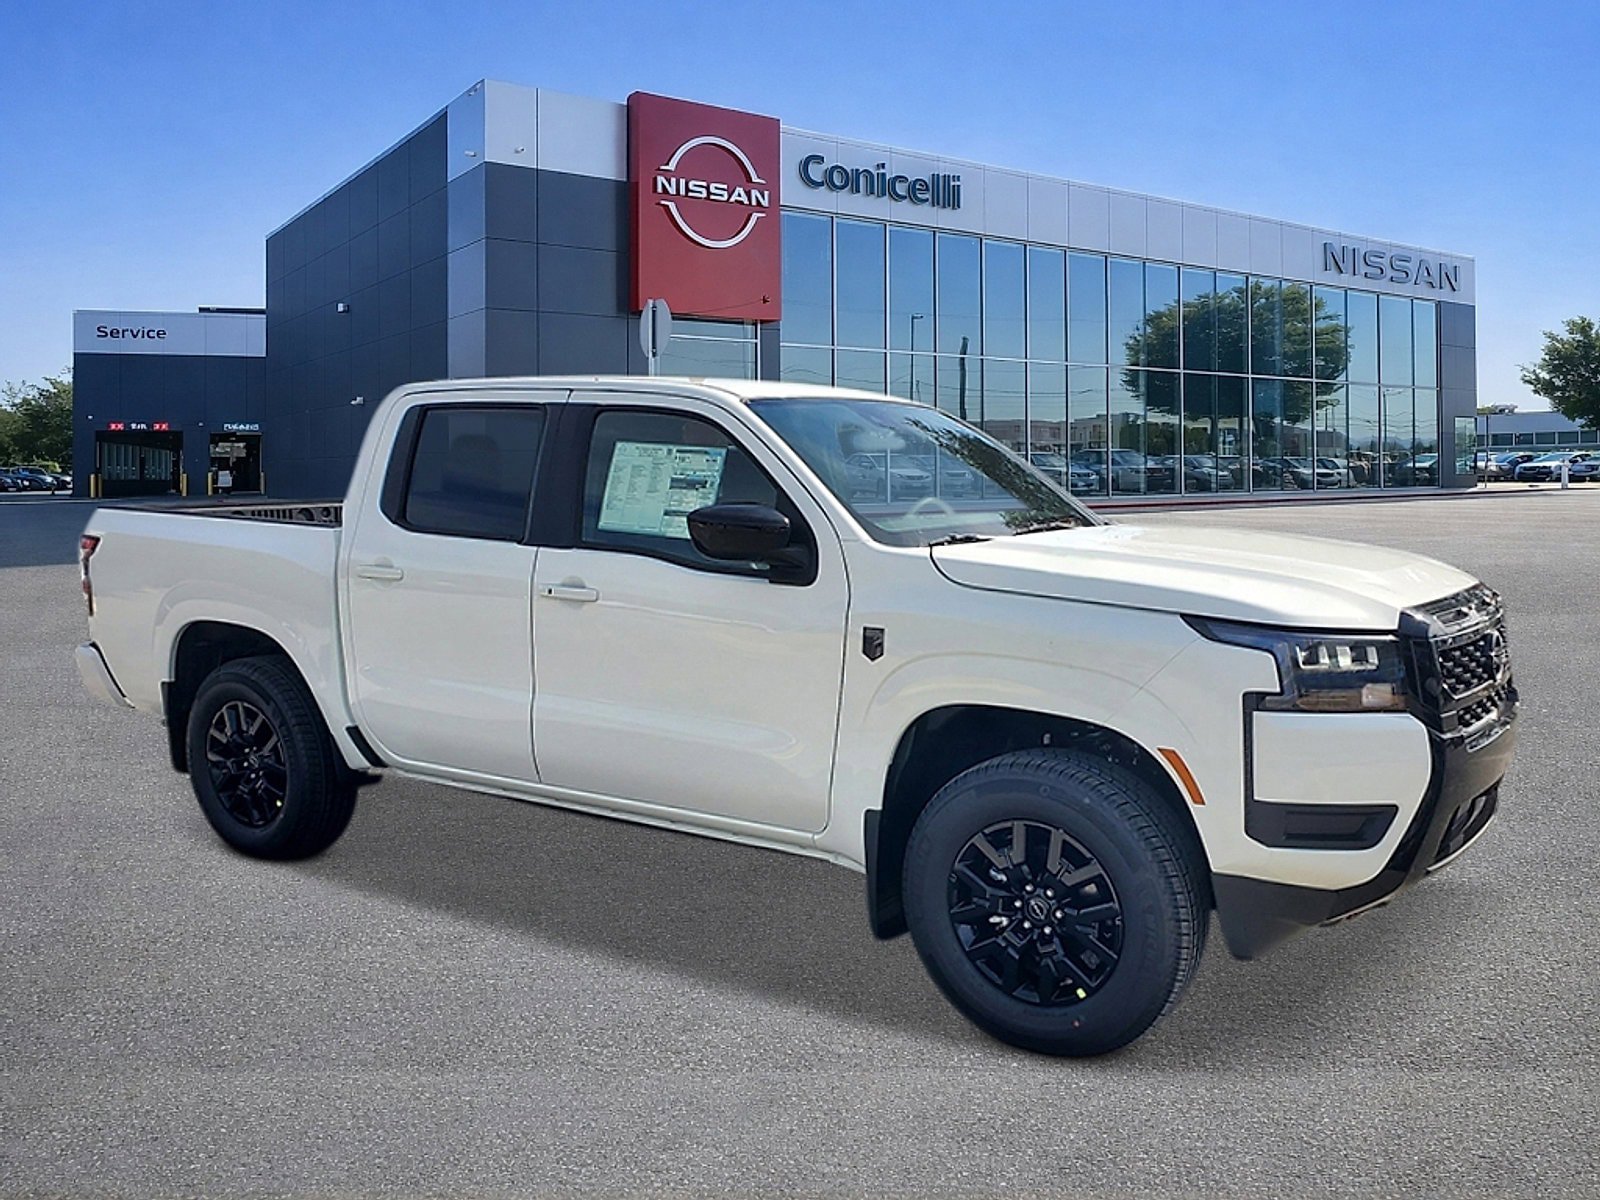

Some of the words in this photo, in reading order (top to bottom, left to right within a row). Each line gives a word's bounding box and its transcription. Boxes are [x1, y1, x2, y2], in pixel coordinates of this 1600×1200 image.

[656, 176, 769, 207] NISSAN
[800, 155, 961, 210] Conicelli
[1323, 242, 1460, 292] NISSAN
[96, 325, 166, 339] Service
